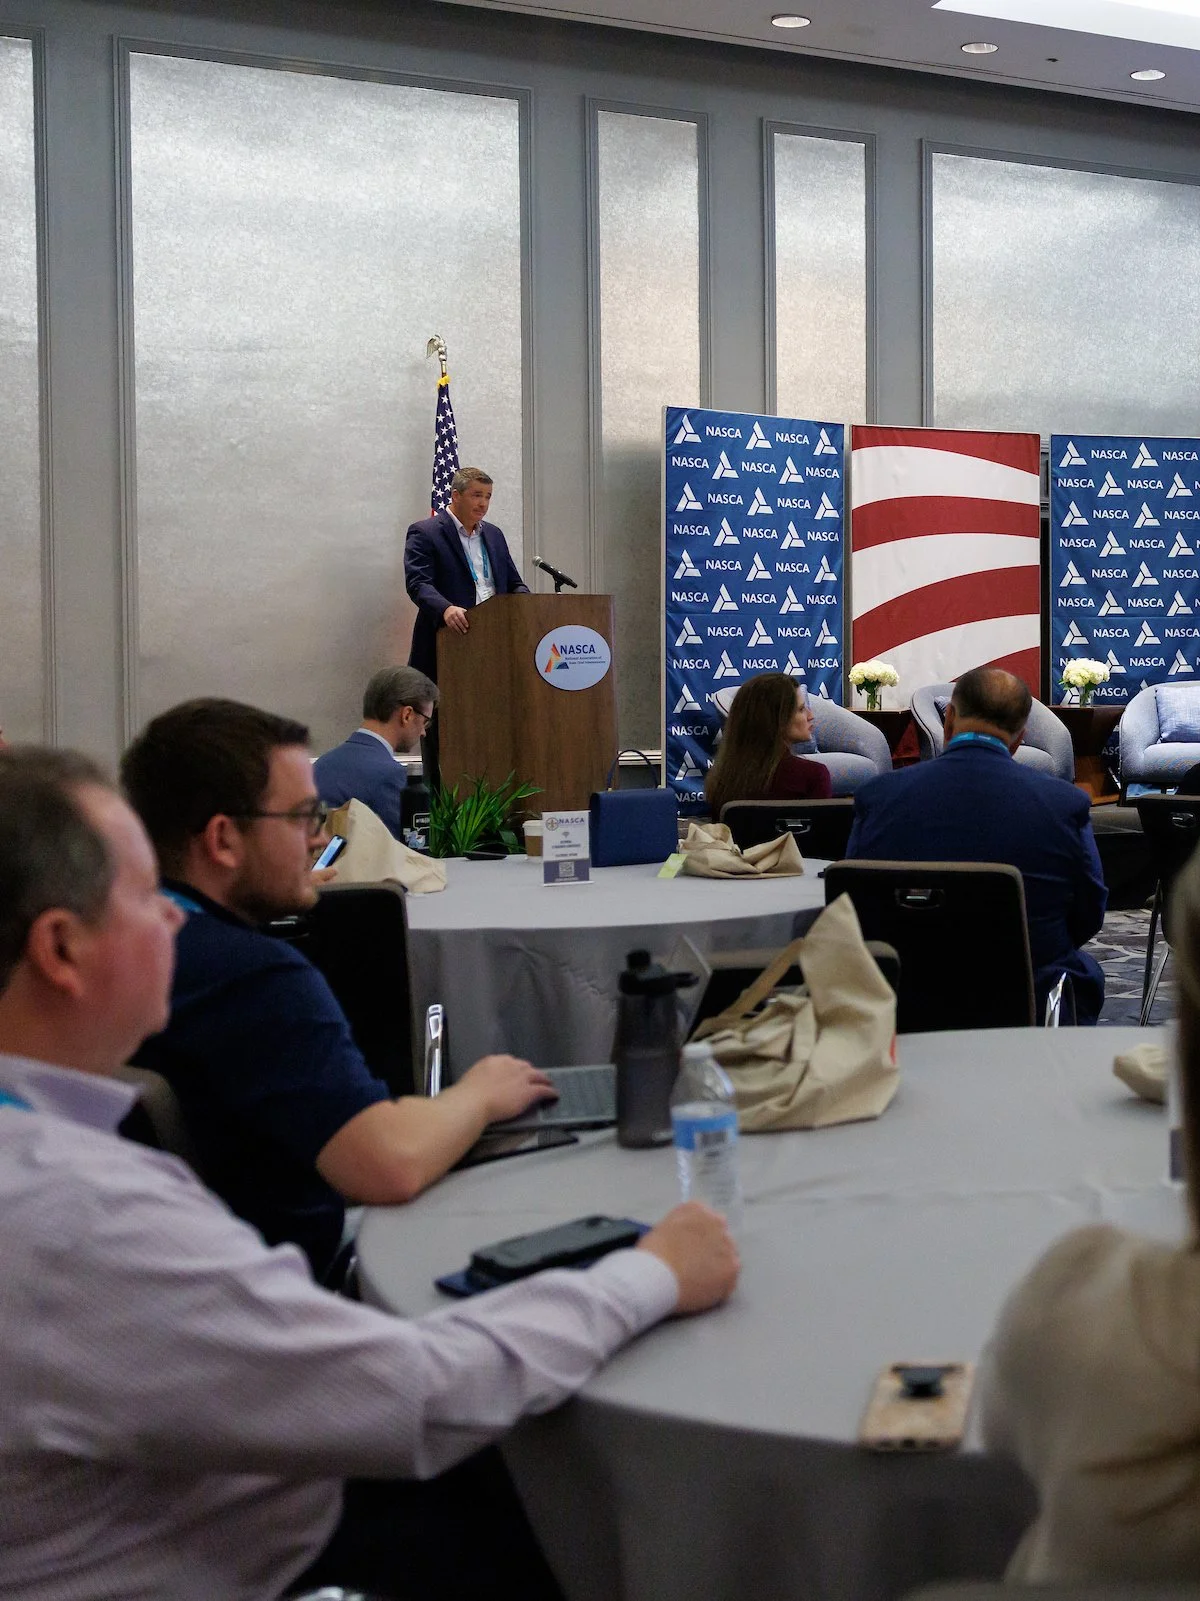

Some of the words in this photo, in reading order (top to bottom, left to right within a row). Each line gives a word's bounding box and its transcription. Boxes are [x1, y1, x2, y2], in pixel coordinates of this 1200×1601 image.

[706, 426, 742, 438] NASCA
[775, 432, 810, 445] NASCA
[1091, 450, 1127, 460] NASCA
[1163, 452, 1199, 461] NASCA
[672, 456, 709, 469] NASCA
[741, 462, 777, 474] NASCA
[805, 467, 840, 479] NASCA
[1058, 478, 1095, 488] NASCA
[1127, 480, 1164, 489] NASCA
[708, 493, 743, 505] NASCA
[777, 498, 811, 509] NASCA
[1093, 510, 1130, 519] NASCA
[1164, 511, 1200, 520] NASCA
[673, 524, 711, 536] NASCA
[743, 528, 778, 539] NASCA
[807, 531, 839, 542] NASCA
[1059, 539, 1096, 548] NASCA
[1129, 539, 1165, 549] NASCA
[705, 560, 742, 571] NASCA
[775, 563, 810, 573] NASCA
[1091, 569, 1128, 578] NASCA
[1163, 569, 1199, 578] NASCA
[671, 592, 709, 602] NASCA
[741, 593, 777, 604] NASCA
[806, 595, 837, 605] NASCA
[1058, 598, 1095, 607] NASCA
[1128, 599, 1164, 607] NASCA
[707, 627, 743, 637] NASCA
[777, 628, 811, 637] NASCA
[1093, 629, 1130, 638] NASCA
[1165, 628, 1200, 637] NASCA
[560, 644, 596, 655] NASCA
[673, 659, 710, 669] NASCA
[743, 659, 778, 669] NASCA
[807, 658, 839, 668] NASCA
[1129, 658, 1166, 667] NASCA
[1093, 687, 1129, 697] NASCA
[671, 726, 709, 736] NASCA
[675, 791, 706, 802] NASC
[558, 817, 585, 825] NASCA
